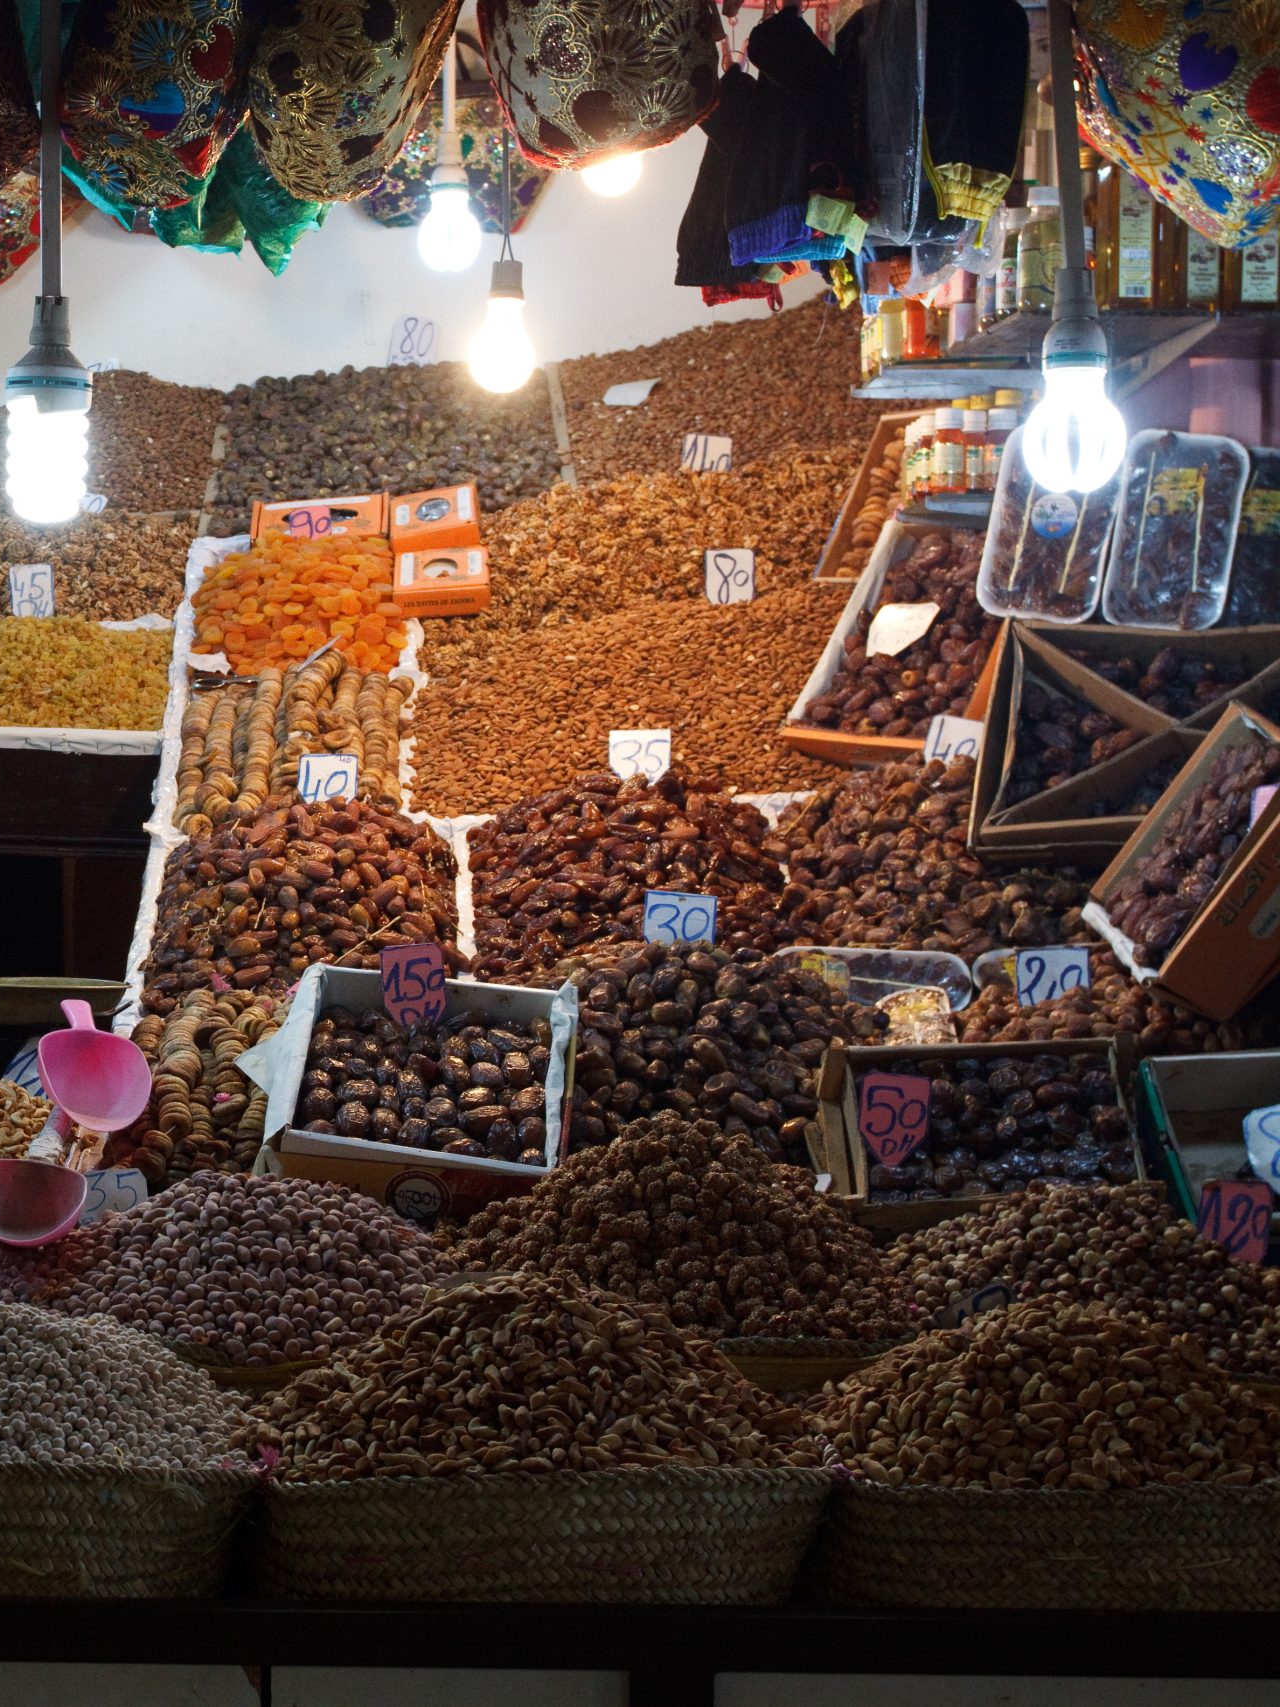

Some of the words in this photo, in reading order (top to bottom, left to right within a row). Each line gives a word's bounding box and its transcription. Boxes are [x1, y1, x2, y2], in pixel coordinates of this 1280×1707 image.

[400, 317, 434, 357] 80
[288, 510, 331, 539] 90
[12, 570, 47, 600] 45
[714, 553, 749, 604] 80
[612, 739, 669, 773] 35
[302, 760, 348, 801] 40
[648, 904, 709, 941] 30
[383, 957, 445, 1003] 150
[866, 1085, 926, 1136] 50
[84, 1171, 138, 1212] 35
